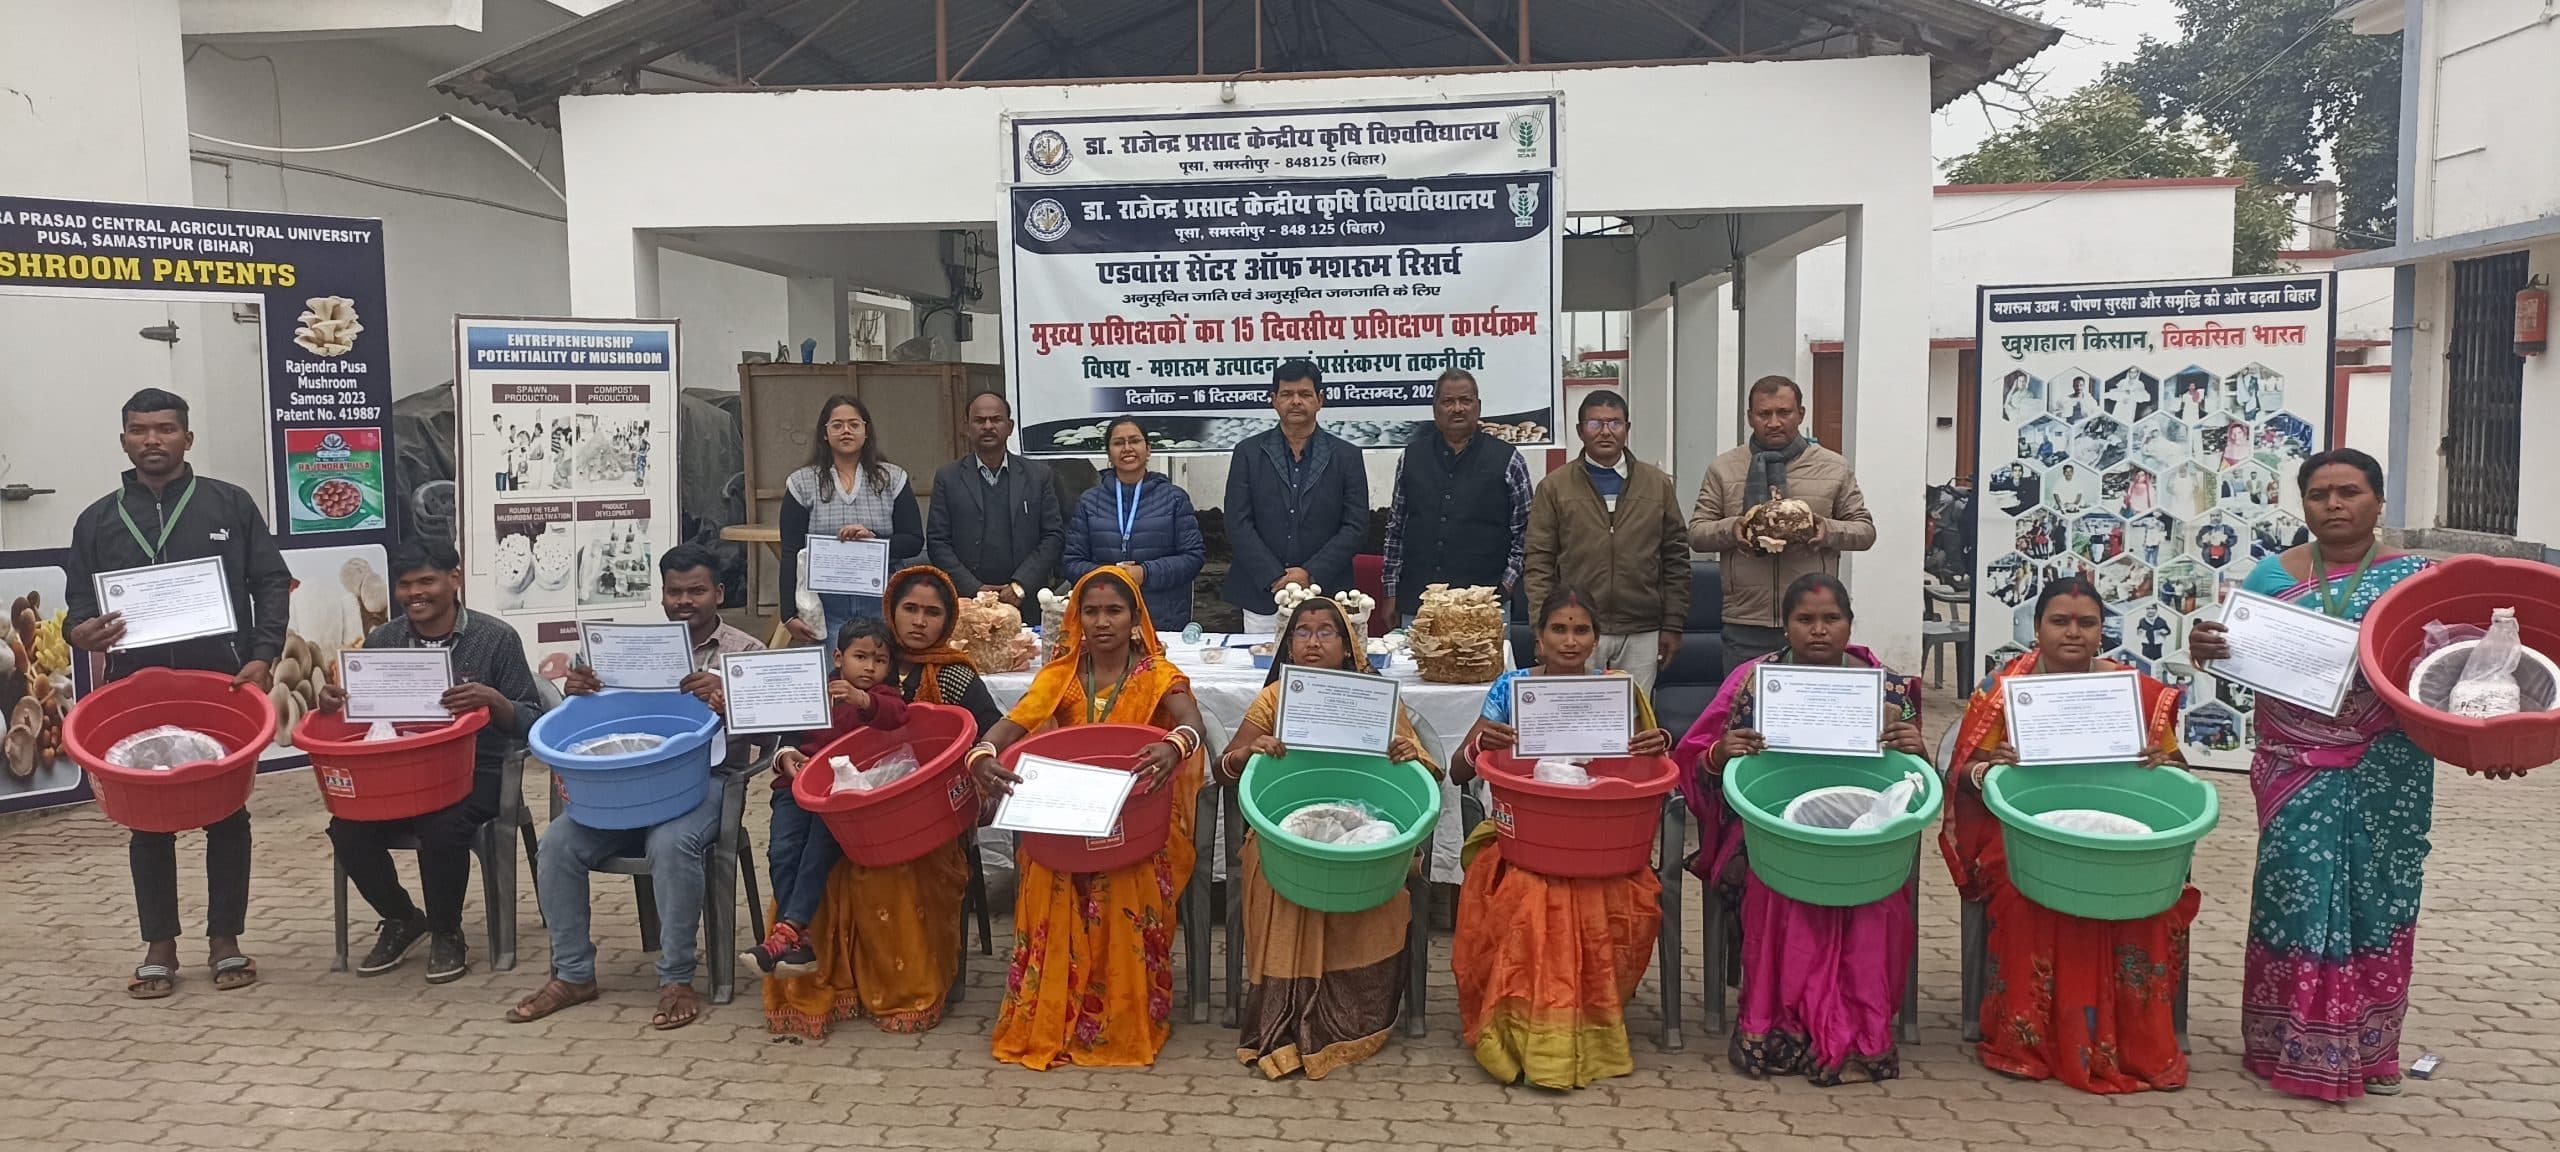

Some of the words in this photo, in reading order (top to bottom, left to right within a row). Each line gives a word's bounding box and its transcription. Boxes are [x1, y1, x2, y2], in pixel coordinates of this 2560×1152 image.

[1083, 137, 1112, 155] डा.
[1119, 131, 1181, 154] राजेन्द्र
[1185, 132, 1241, 153] प्रसाद
[1246, 125, 1315, 151] केन्द्रीय
[1318, 123, 1362, 152] कृषि
[1367, 120, 1500, 146] विश्वविद्यालय
[1179, 160, 1208, 175] पूसा,
[1213, 155, 1269, 174] समस्तीपुर
[1285, 156, 1336, 169] 848125
[1341, 152, 1386, 167] (बिहार)
[1081, 201, 1111, 221] डा.
[1116, 194, 1179, 220] राजेन्द्र
[1182, 198, 1240, 219] प्रसाद
[1242, 190, 1311, 217] केन्द्रीय
[1314, 188, 1360, 220] कृषि
[1364, 186, 1497, 213] विश्वविद्यालय
[19, 211, 87, 229] PRASAD
[92, 216, 166, 233] CENTRAL
[170, 220, 285, 240] AGRICULTURAL
[288, 227, 372, 243] UNIVERSITY
[1174, 227, 1204, 243] पूसा,
[1208, 221, 1265, 241] समस्तीपुर
[1280, 224, 1306, 236] 848
[1310, 223, 1335, 235] 125
[1339, 219, 1385, 236] (बिहार)
[37, 230, 87, 249] PUSA,
[92, 233, 194, 251] SAMASTIPUR
[198, 239, 254, 256] (BIHAR)
[0, 251, 142, 282] SHROOM
[152, 258, 296, 287] PATENTS
[1096, 254, 1179, 284] एडवांस
[1184, 252, 1237, 282] सेंटर
[1244, 251, 1302, 281] ऑफ
[1397, 246, 1463, 277] रिसर्च
[1122, 289, 1189, 308] अनुसूचित
[1192, 288, 1228, 302] जाति
[1231, 287, 1252, 301] एवं
[1255, 286, 1322, 305] अनुसूचित
[1326, 284, 1390, 299] जनजाति
[1393, 283, 1410, 297] के
[1412, 283, 1441, 297] लिए
[1994, 301, 2032, 315] मशरूम
[2034, 299, 2060, 314] उद्यम
[2070, 294, 2101, 312] पोषण
[2104, 296, 2137, 316] सुरक्षा
[2140, 290, 2162, 310] और
[2164, 288, 2201, 314] समृद्धि
[2204, 288, 2221, 307] की
[2224, 287, 2247, 306] ओर
[2249, 290, 2281, 308] बढ़ता
[2284, 284, 2317, 304] बिहार
[507, 333, 634, 349] ENTREPRENEURSHIP
[1030, 322, 1084, 355] मुख्य
[1088, 313, 1190, 347] प्रशिक्षकों
[1193, 319, 1225, 343] का
[1231, 316, 1256, 343] 15
[1260, 309, 1347, 342] दिवसीय
[1351, 308, 1445, 340] प्रशिक्षण
[1449, 305, 1538, 337] कार्यक्रम
[2001, 333, 2077, 360] खुशहाल
[2082, 325, 2154, 353] किसान,
[2162, 321, 2246, 348] विकसित
[2252, 324, 2306, 346] भारत
[285, 360, 338, 376] Rajendra
[340, 360, 367, 373] Pusa
[477, 349, 568, 363] POTENTIALITY
[571, 351, 587, 363] OF
[589, 351, 662, 365] MUSHROOM
[1082, 356, 1131, 379] विषय
[1406, 347, 1485, 373] तकनीकी
[298, 376, 357, 389] Mushroom
[516, 385, 548, 393] SPAWN
[593, 385, 633, 394] COMPOST
[290, 392, 335, 406] Samosa
[338, 391, 366, 405] 2023
[504, 393, 560, 402] PRODUCTION
[588, 393, 640, 402] PRODUCTION
[1125, 388, 1177, 405] दिनांक
[1192, 389, 1206, 403] 16
[1208, 387, 1272, 404] दिसम्बर,
[1326, 386, 1341, 400] 30
[1344, 384, 1408, 401] दिसम्बर,
[1412, 384, 1435, 399] 202
[276, 408, 315, 421] Patent
[317, 408, 337, 421] No.
[339, 407, 381, 421] 419887
[496, 514, 533, 522] MUSHROOM
[533, 512, 571, 521] CULTIVATION
[508, 506, 530, 514] ROUND
